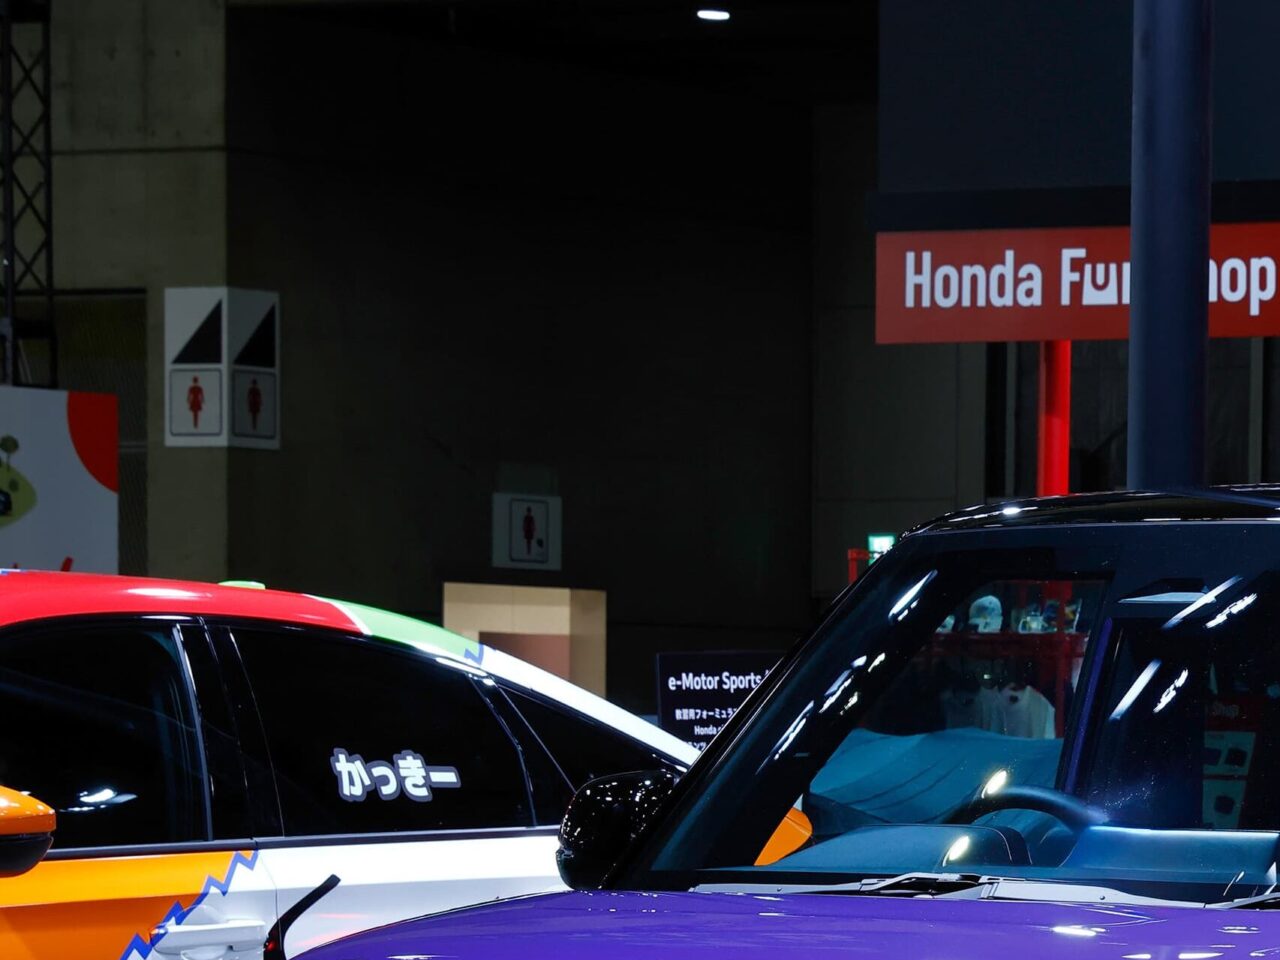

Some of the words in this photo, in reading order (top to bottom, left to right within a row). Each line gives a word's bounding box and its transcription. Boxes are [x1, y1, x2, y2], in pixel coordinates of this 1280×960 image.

[905, 249, 1042, 308] Honda
[668, 672, 720, 691] e-Motor
[721, 671, 762, 693] Sports
[331, 748, 460, 801] かっきー
